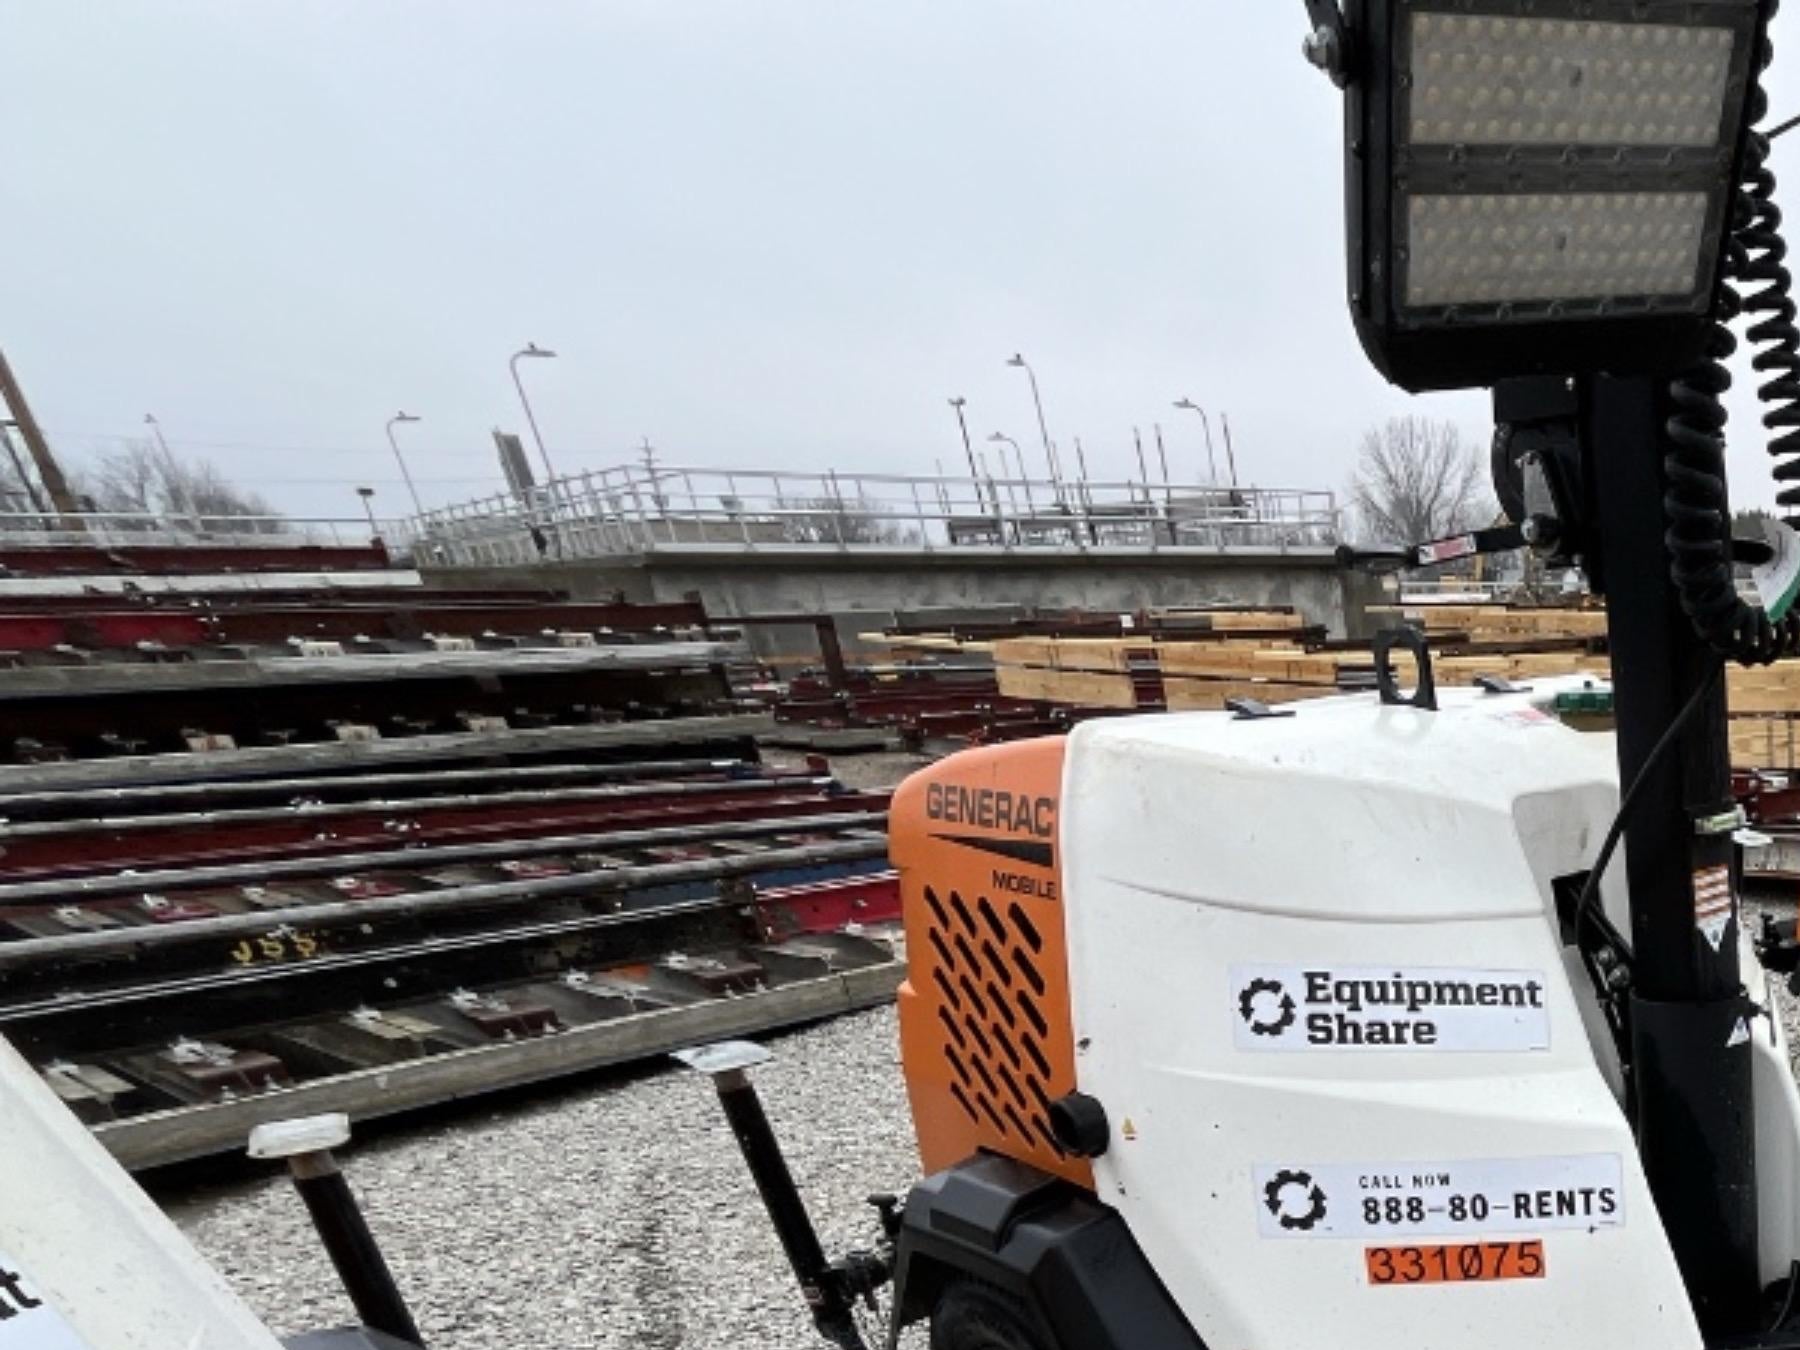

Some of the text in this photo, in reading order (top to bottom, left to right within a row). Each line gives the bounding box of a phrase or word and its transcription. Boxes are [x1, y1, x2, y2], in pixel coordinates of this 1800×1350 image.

[926, 782, 1054, 837] GENERAC
[992, 869, 1057, 901] MOBILE
[1303, 972, 1543, 1012] Equipment
[1306, 1013, 1438, 1045] Share
[1358, 1172, 1451, 1190] CALL NOW
[1361, 1187, 1617, 1226] 888-80-RENTS
[1369, 1241, 1542, 1285] 331075
